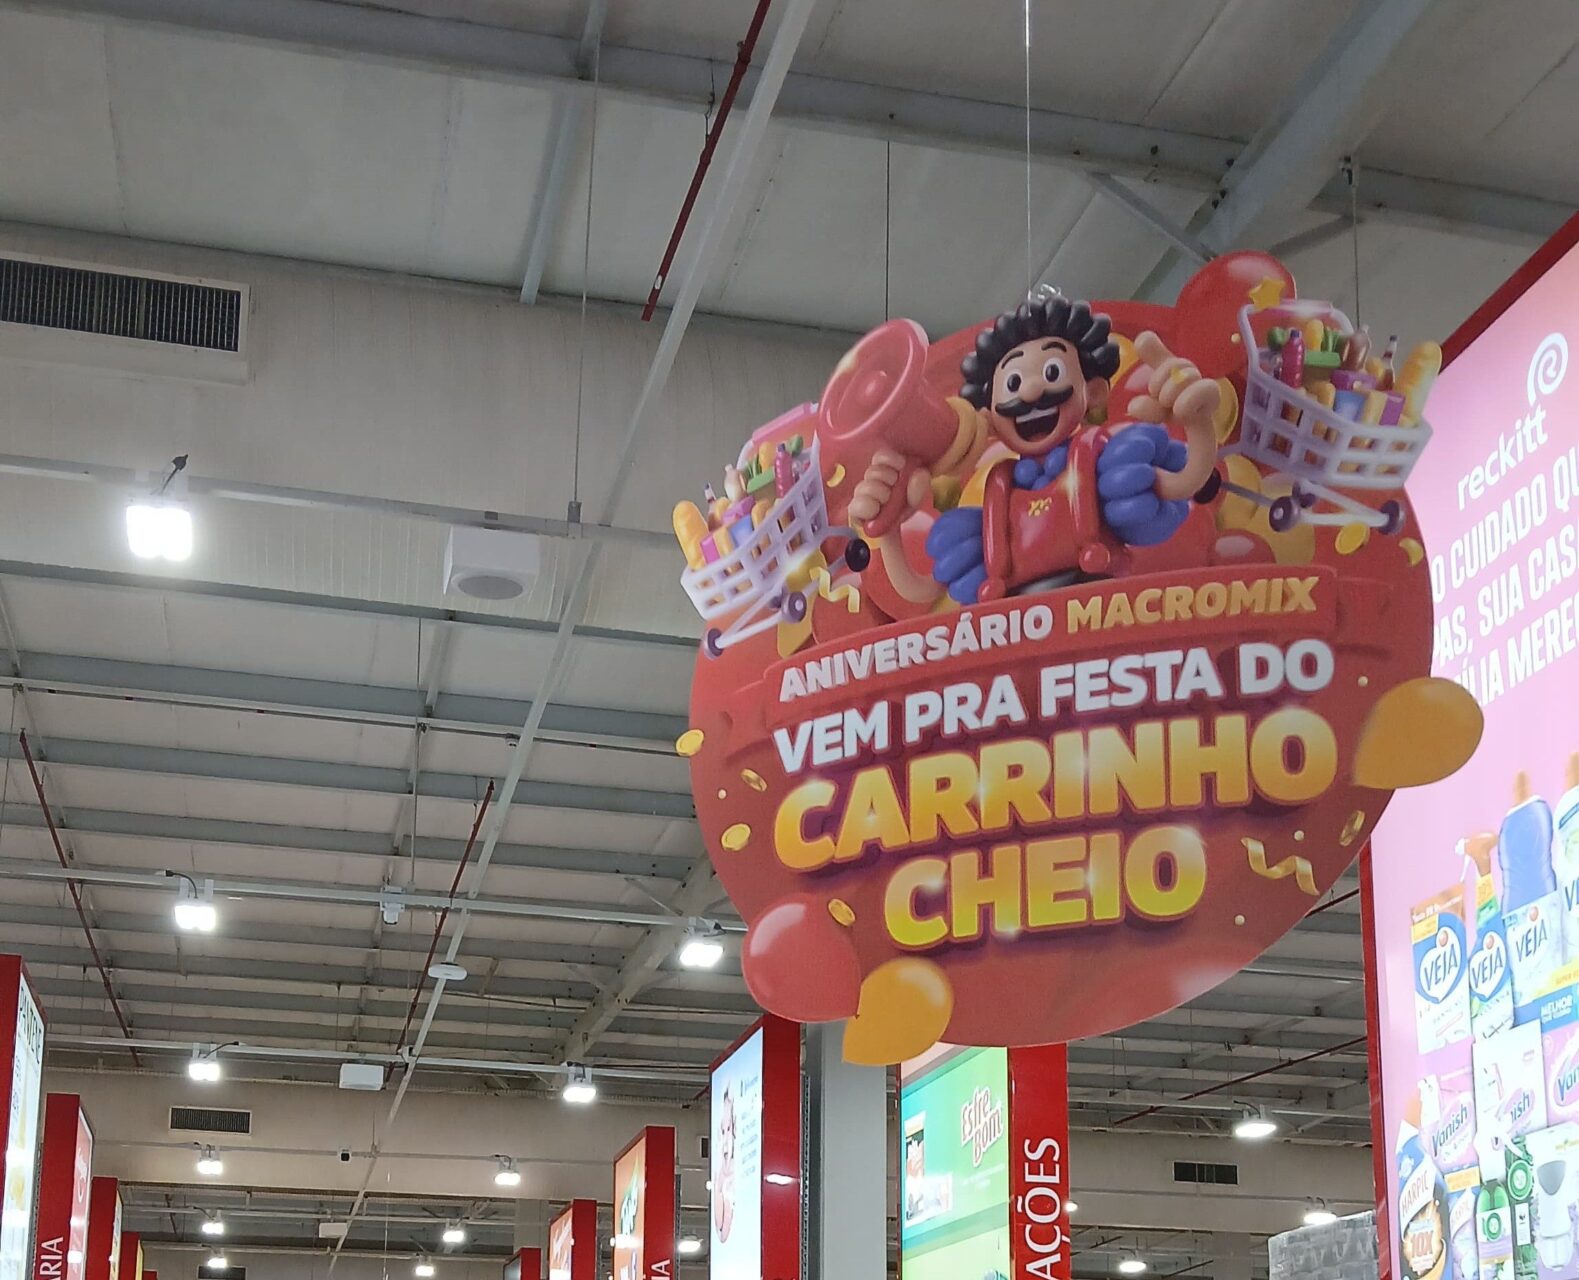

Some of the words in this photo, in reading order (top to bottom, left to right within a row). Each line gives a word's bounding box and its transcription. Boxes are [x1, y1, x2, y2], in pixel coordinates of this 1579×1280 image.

[1457, 405, 1548, 511] reckitt
[1450, 472, 1548, 590] CUIDADO
[1478, 563, 1525, 637] SUA
[1528, 523, 1579, 601] CAS
[780, 603, 1054, 702] ANIVERSÁRIO
[1066, 575, 1319, 634] MACROMIX
[1454, 648, 1504, 707] ÍLIA
[773, 702, 889, 775] VEM
[904, 673, 1025, 744] PRA
[1039, 647, 1224, 717] FESTA
[1239, 640, 1335, 694] DO
[774, 705, 1339, 872] CARRINHO
[884, 824, 1208, 948] CHEIO
[1516, 919, 1547, 963] VEJA
[1424, 943, 1458, 991] VEJA
[1472, 947, 1503, 989] VEJA
[1432, 1104, 1468, 1157] Vanish
